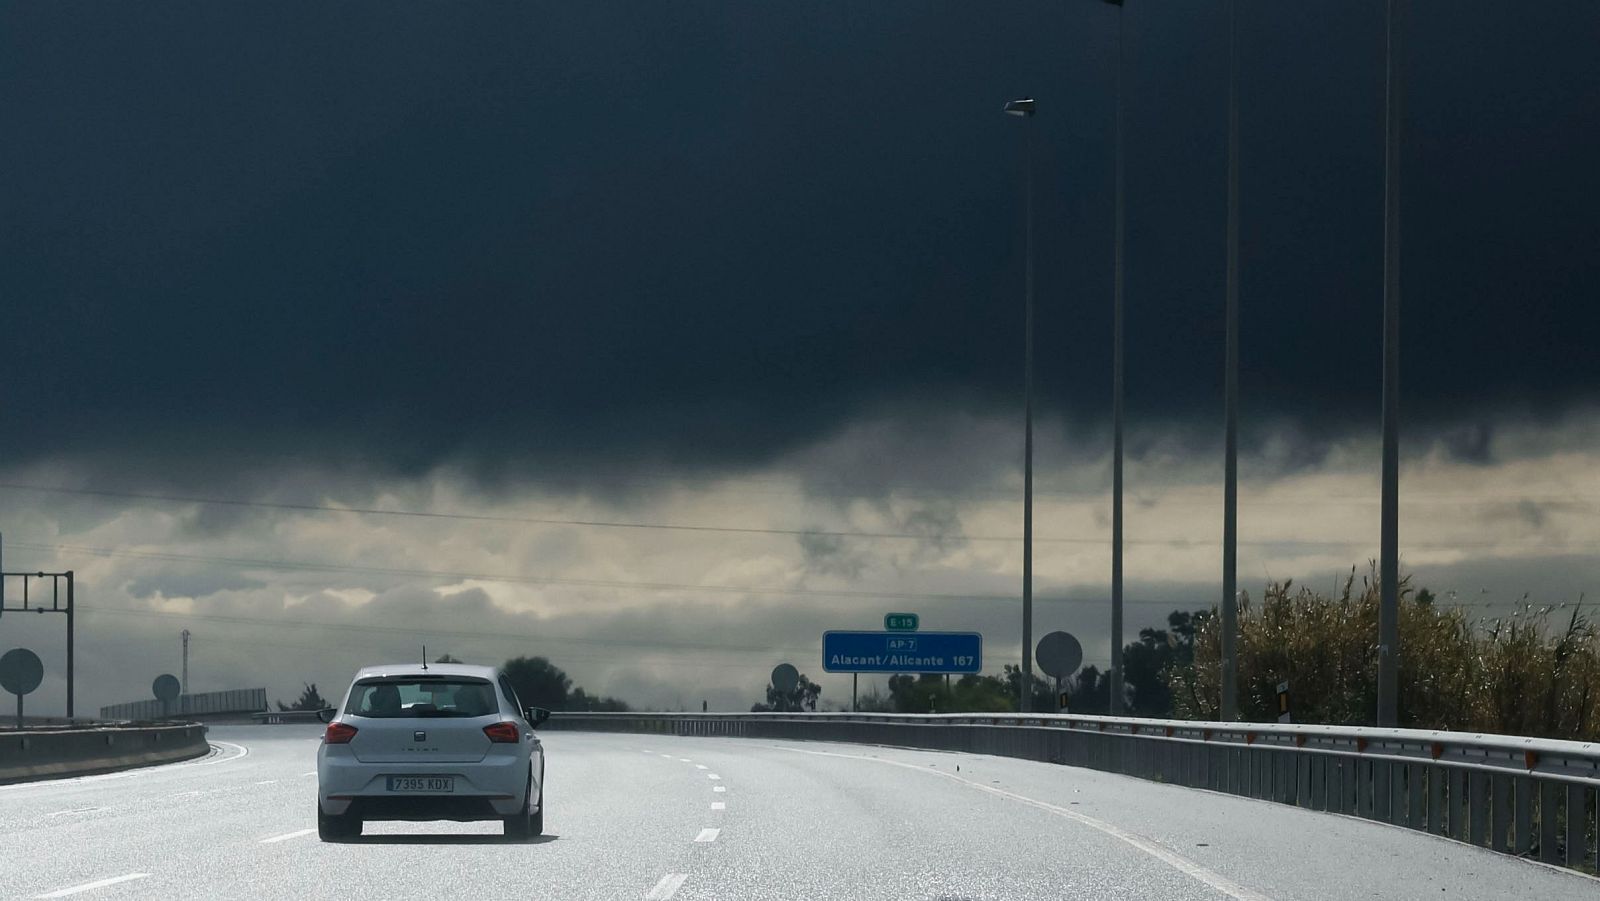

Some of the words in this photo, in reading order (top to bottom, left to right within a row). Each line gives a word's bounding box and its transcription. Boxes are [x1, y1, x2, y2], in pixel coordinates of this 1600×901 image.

[888, 639, 915, 649] AP-7
[831, 654, 944, 666] Alacant/Alicante
[952, 655, 975, 666] 167
[395, 778, 424, 790] 7395
[427, 778, 449, 790] KDX
